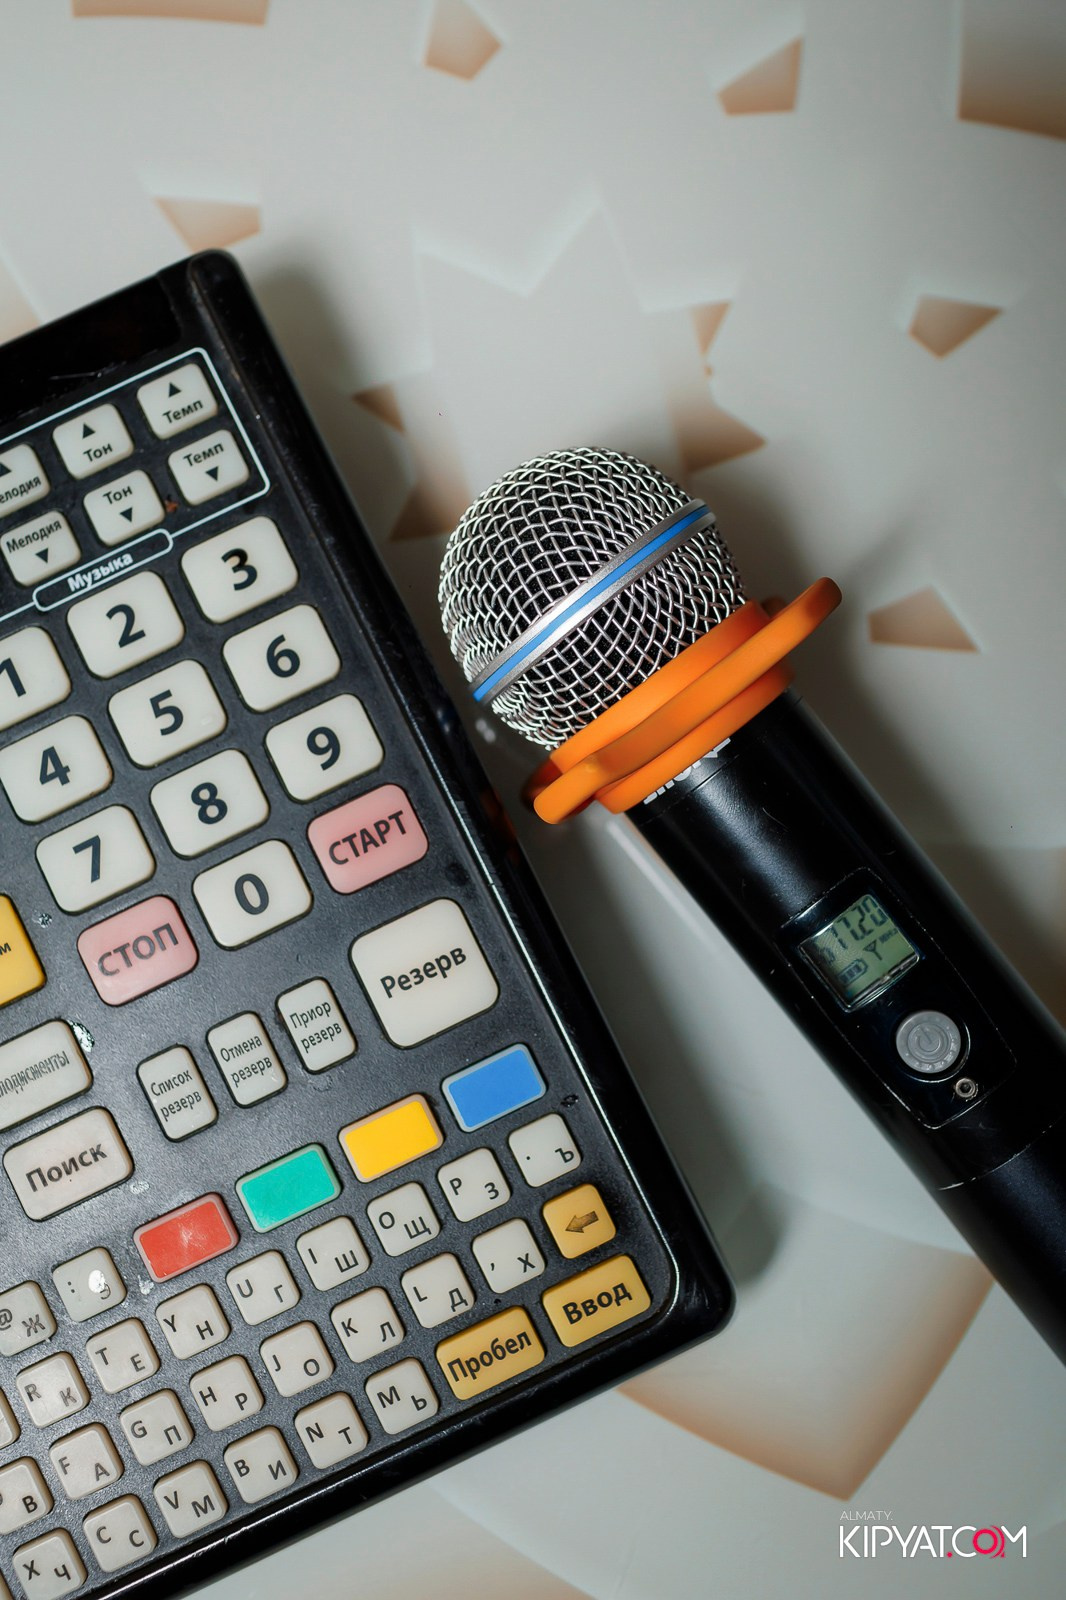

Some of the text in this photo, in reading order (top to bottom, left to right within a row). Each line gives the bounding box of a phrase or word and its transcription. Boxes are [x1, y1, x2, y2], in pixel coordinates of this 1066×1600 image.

[162, 399, 204, 425] Темп
[83, 443, 114, 463] Тон
[183, 442, 225, 468] Темп
[102, 485, 133, 506] Тон
[6, 520, 62, 554] Мелодия
[66, 553, 133, 592] Музыка
[222, 548, 257, 590] 3
[106, 604, 146, 648] 2
[267, 635, 300, 678] 6
[0, 658, 26, 697] 1
[150, 690, 183, 735] 5
[307, 727, 340, 770] 9
[40, 746, 70, 786] 4
[191, 782, 227, 824] 8
[328, 810, 410, 866] СТАРТ
[73, 835, 100, 883] 7
[235, 874, 269, 915] 0
[97, 922, 179, 977] СТОП
[379, 947, 467, 999] Резерв
[289, 1001, 332, 1029] Приор
[219, 1034, 263, 1063] Отмена
[300, 1023, 342, 1053] резерв
[150, 1069, 193, 1097] Список
[231, 1056, 273, 1088] резерв
[160, 1090, 202, 1121] резерв
[555, 1147, 575, 1164] Ъ
[25, 1143, 108, 1193] Поиск
[449, 1177, 463, 1196] P
[484, 1181, 500, 1200] З
[378, 1211, 396, 1230] O
[403, 1216, 432, 1241] Щ
[307, 1247, 318, 1265] I
[334, 1250, 360, 1274] Ш
[516, 1252, 536, 1274] Х
[236, 1279, 254, 1299] U
[273, 1284, 284, 1303] Г
[416, 1286, 428, 1303] L
[448, 1287, 469, 1312] Д
[562, 1282, 633, 1326] Ввод
[21, 1314, 46, 1338] Ж
[163, 1314, 177, 1334] Y
[195, 1319, 215, 1341] Н
[340, 1317, 359, 1338] K
[379, 1321, 396, 1343] Л
[94, 1346, 109, 1366] T
[129, 1353, 146, 1373] Е
[272, 1354, 282, 1372] J
[447, 1331, 532, 1383] Пробел
[303, 1358, 321, 1377] О
[24, 1383, 42, 1403] R
[60, 1387, 78, 1408] К
[199, 1386, 218, 1407] H
[234, 1392, 248, 1411] Р
[376, 1385, 401, 1409] M
[410, 1395, 428, 1412] Ь
[130, 1419, 148, 1439] G
[163, 1424, 183, 1446] П
[304, 1422, 325, 1443] N
[337, 1426, 353, 1445] Т
[57, 1457, 72, 1476] F
[94, 1462, 111, 1482] А
[233, 1459, 251, 1478] B
[267, 1459, 287, 1481] И
[21, 1495, 38, 1514] В
[163, 1490, 180, 1510] V
[190, 1494, 216, 1518] М
[95, 1525, 112, 1545] C
[128, 1529, 145, 1548] С
[22, 1559, 41, 1581] X
[53, 1564, 72, 1581] Ч
